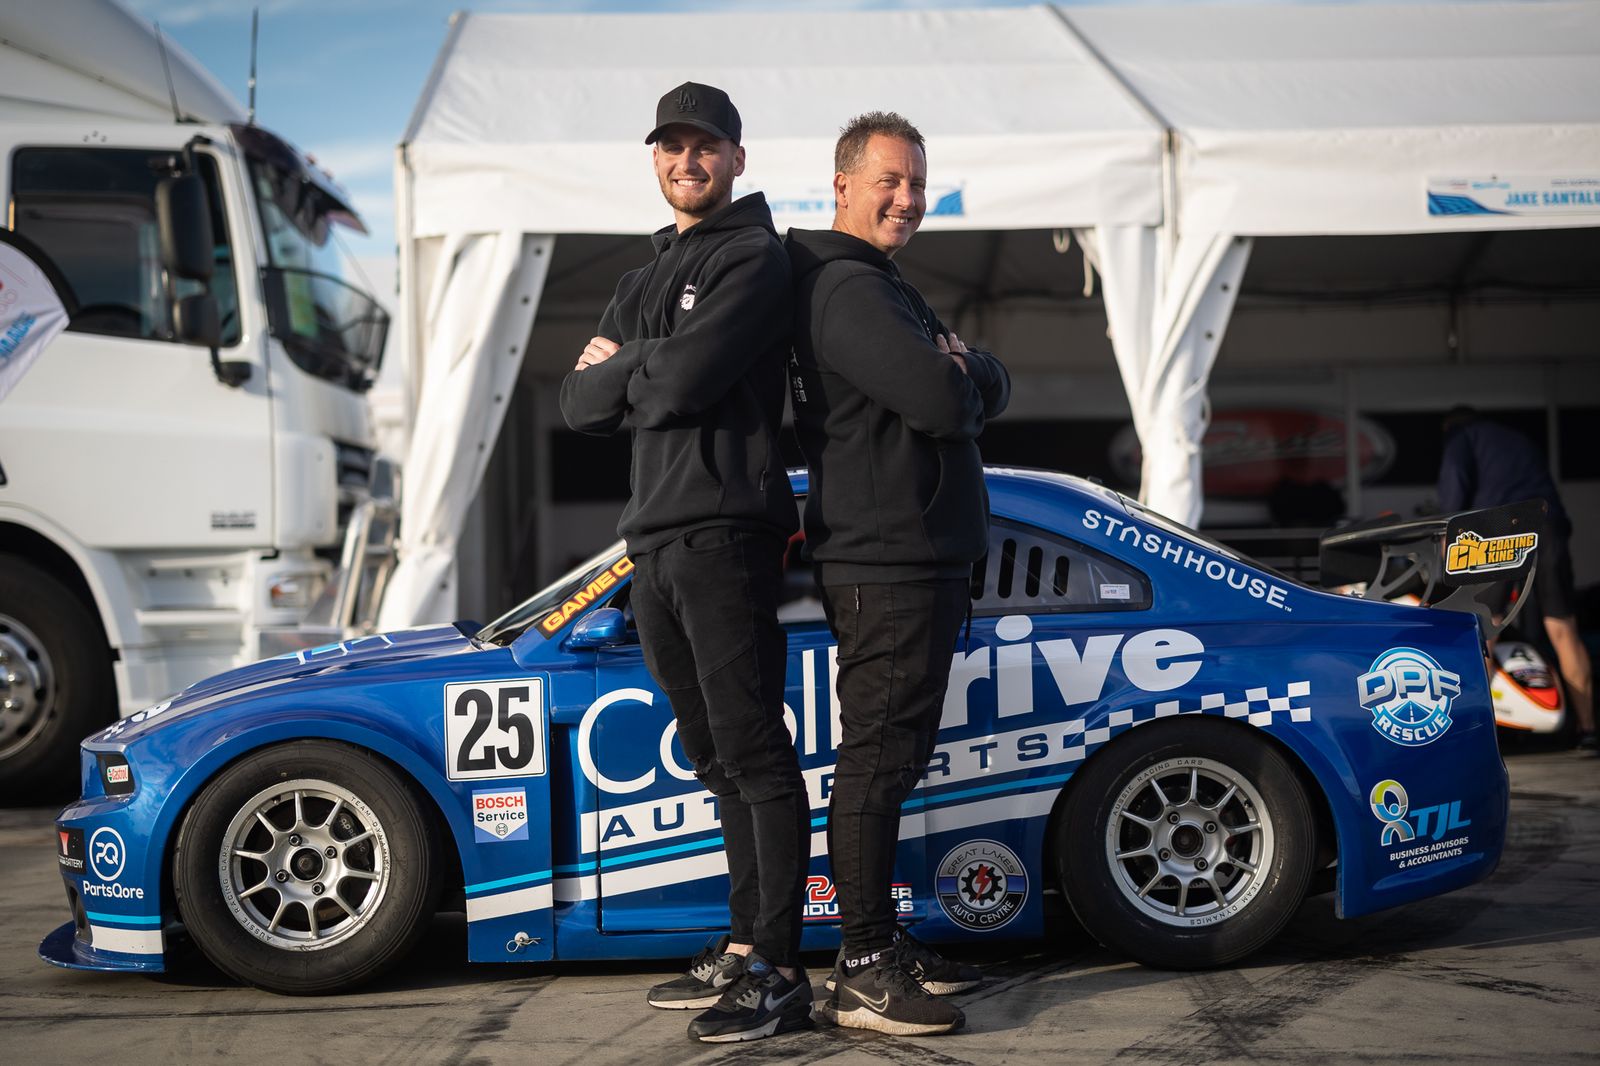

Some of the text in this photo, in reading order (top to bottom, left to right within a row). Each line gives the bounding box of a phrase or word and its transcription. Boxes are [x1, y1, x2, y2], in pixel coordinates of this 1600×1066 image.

[676, 89, 697, 112] LA
[1489, 534, 1535, 552] COATING
[1082, 509, 1288, 609] STASHHOUSE
[1488, 548, 1515, 564] KING
[542, 570, 618, 632] GAME
[1357, 665, 1461, 709] DPF
[454, 686, 535, 772] 25
[1376, 713, 1448, 742] RESCUE
[1136, 761, 1171, 783] RACING
[350, 796, 372, 818] TEAM
[475, 795, 524, 810] BOSCH
[476, 810, 525, 823] Service
[1408, 799, 1472, 841] TJL
[947, 847, 1016, 875] GREAT LAKES
[1389, 836, 1470, 861] BUSINESS ADVISORS
[1398, 847, 1463, 869] & ACCOUNTANTS
[82, 880, 145, 899] PartsQore
[222, 878, 240, 914] RACING
[950, 900, 1015, 924] AUTO CENTRE
[1189, 880, 1262, 926] TEAM DYNAMICS
[241, 916, 273, 942] AUSSIE
